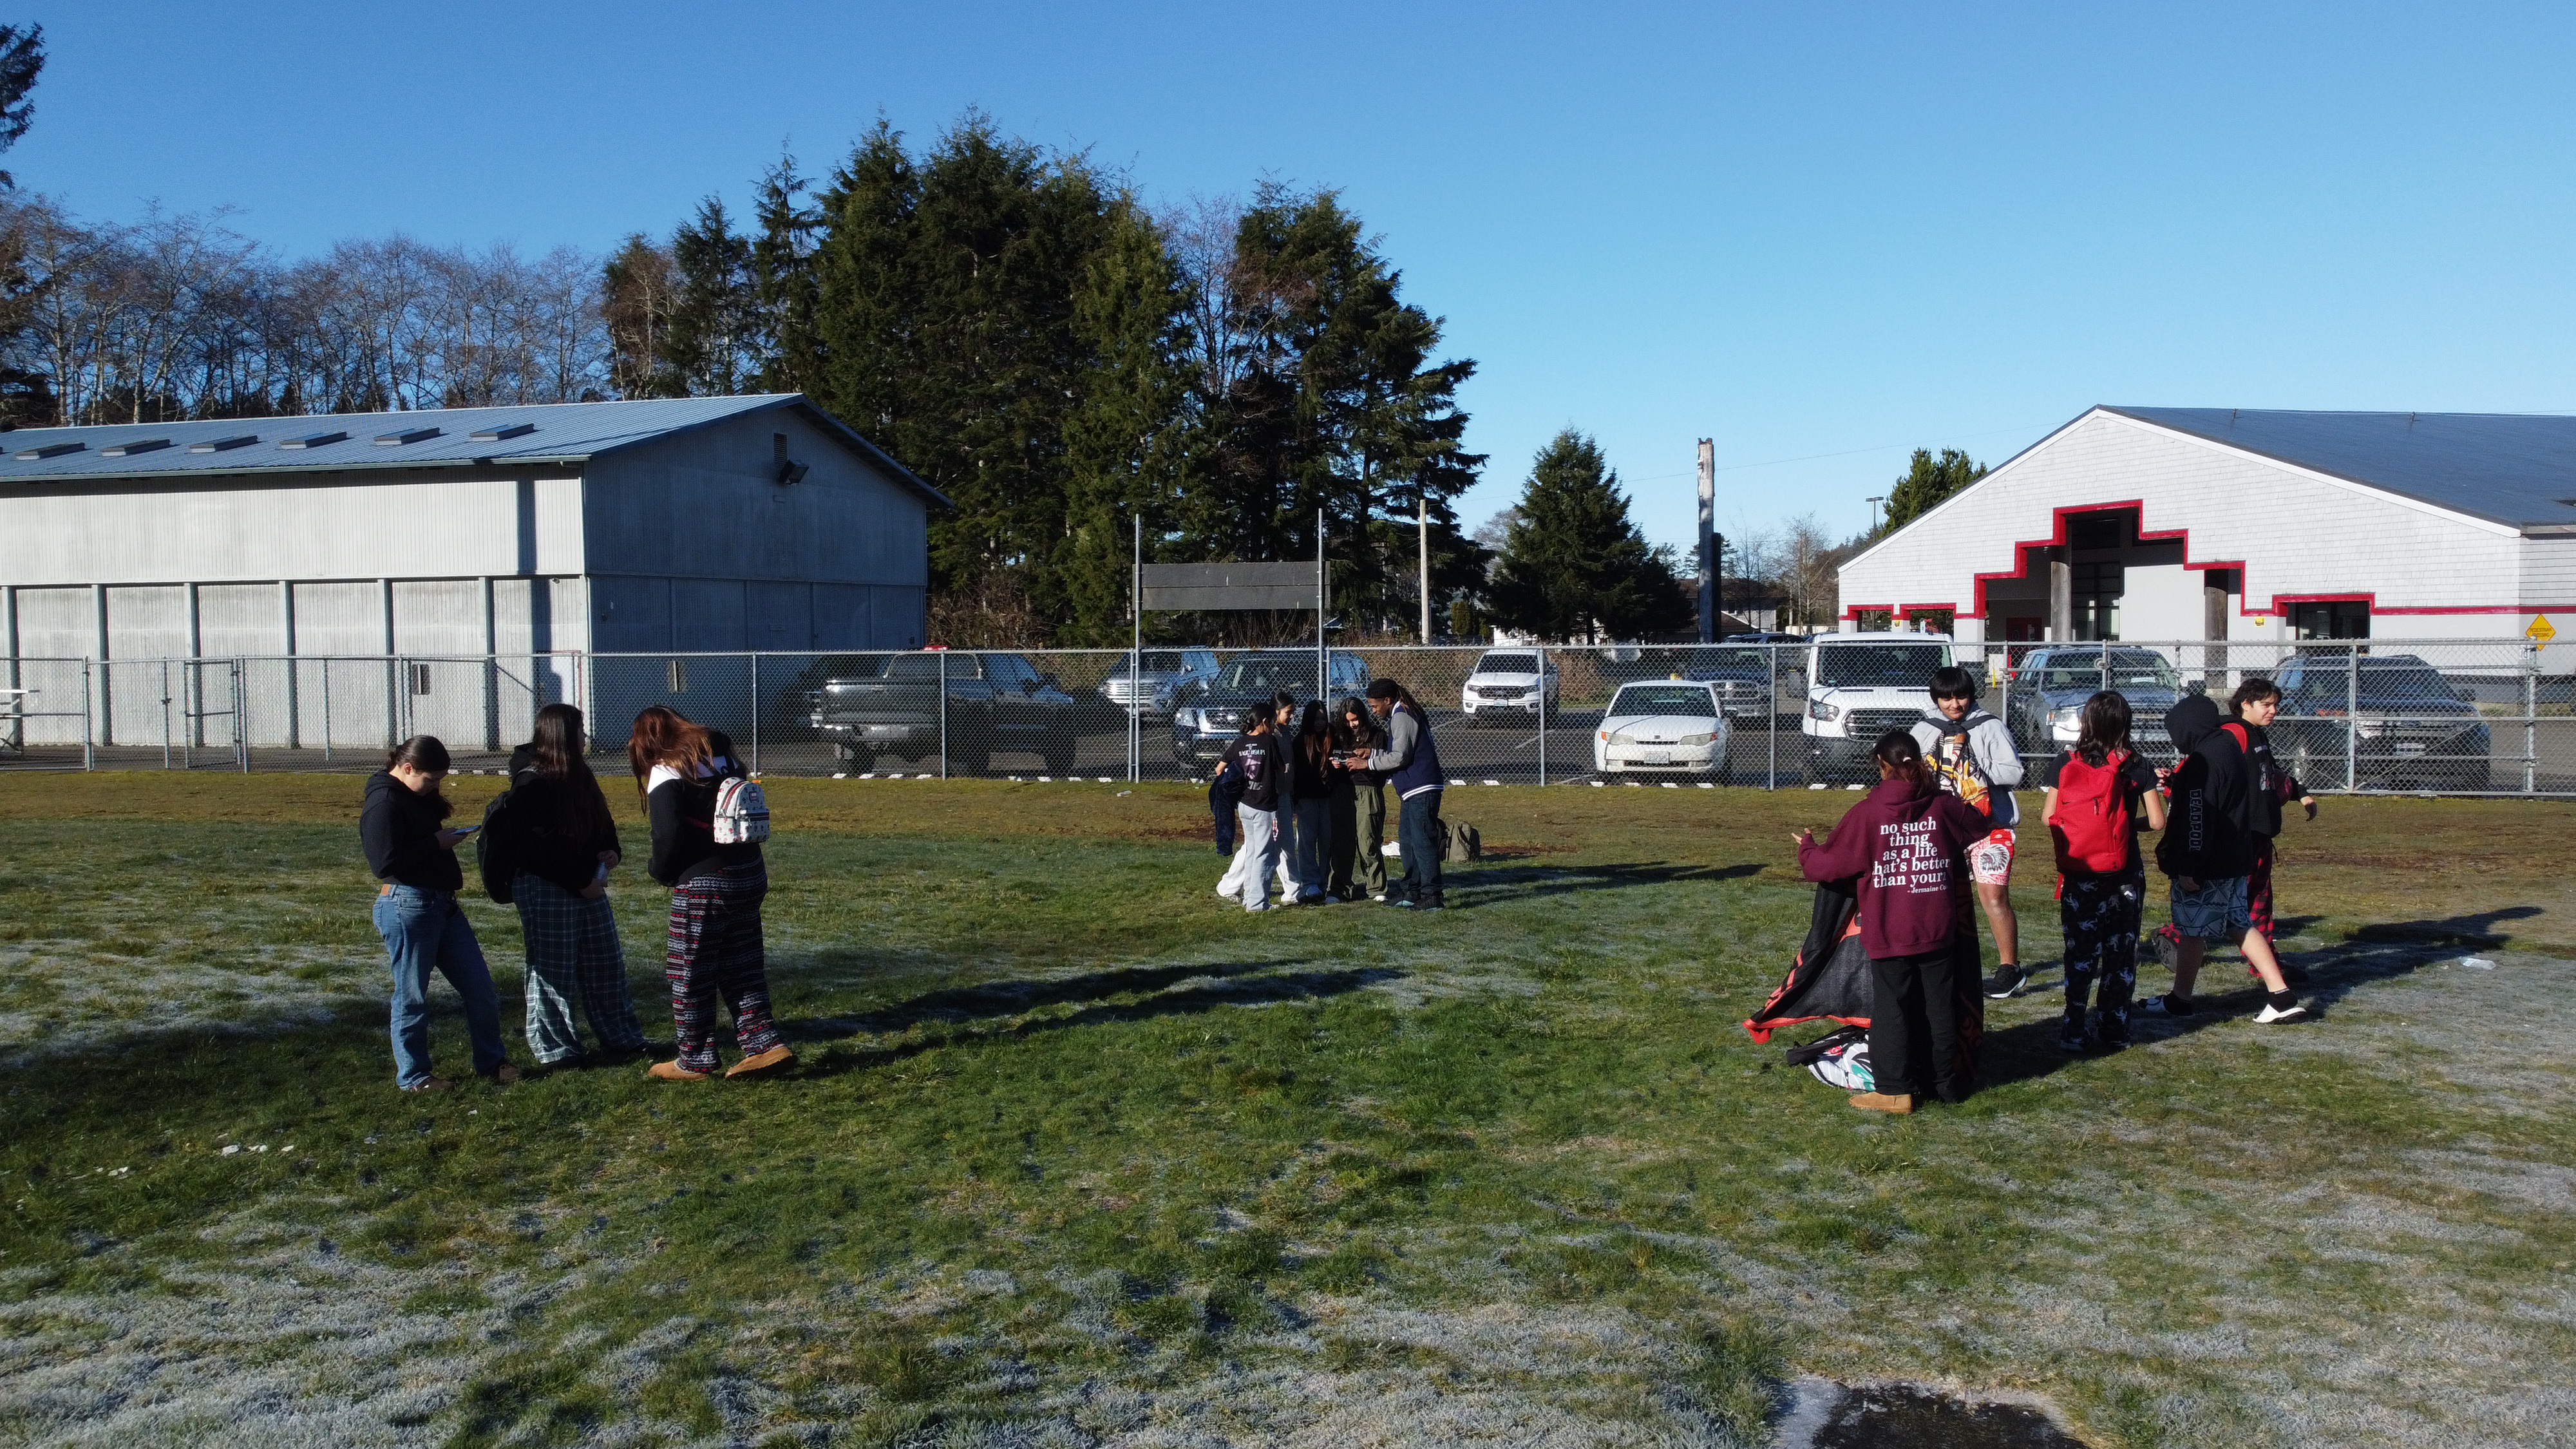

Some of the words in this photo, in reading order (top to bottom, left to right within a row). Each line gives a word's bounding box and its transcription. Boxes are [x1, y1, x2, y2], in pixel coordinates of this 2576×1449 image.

[1880, 823, 1898, 835] no
[1902, 816, 1937, 833] such
[1889, 831, 1930, 847] thing
[1882, 849, 1897, 861] as
[1901, 848, 1910, 859] a
[1915, 842, 1938, 858] life
[1872, 858, 1908, 876] hat's
[1911, 857, 1951, 871] better
[1873, 874, 1906, 888] than
